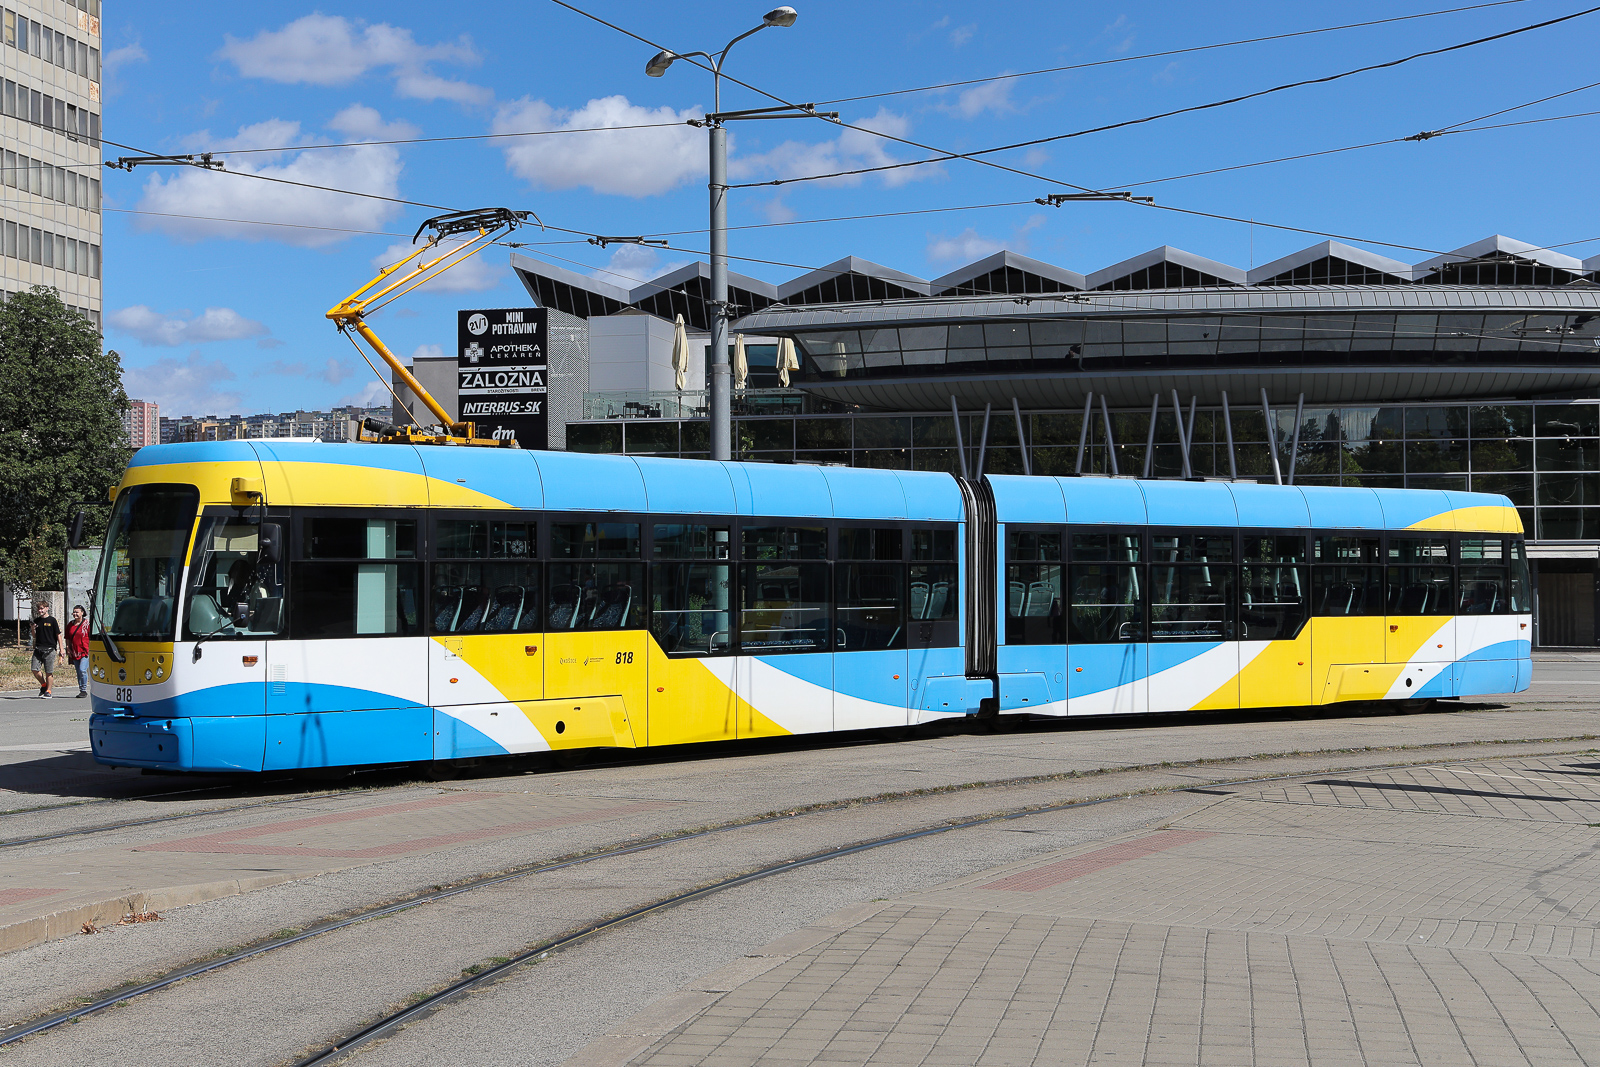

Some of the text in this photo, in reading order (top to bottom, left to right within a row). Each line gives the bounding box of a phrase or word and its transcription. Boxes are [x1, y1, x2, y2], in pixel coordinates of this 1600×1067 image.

[506, 312, 524, 322] MINI
[492, 322, 537, 334] POTRAVINY
[490, 344, 540, 352] APOTHEKA
[462, 366, 543, 387] ZÁLOŽŇA
[463, 401, 542, 413] INTERBUS-SK
[492, 426, 515, 440] dm
[615, 652, 633, 664] 818
[116, 688, 132, 702] 818
